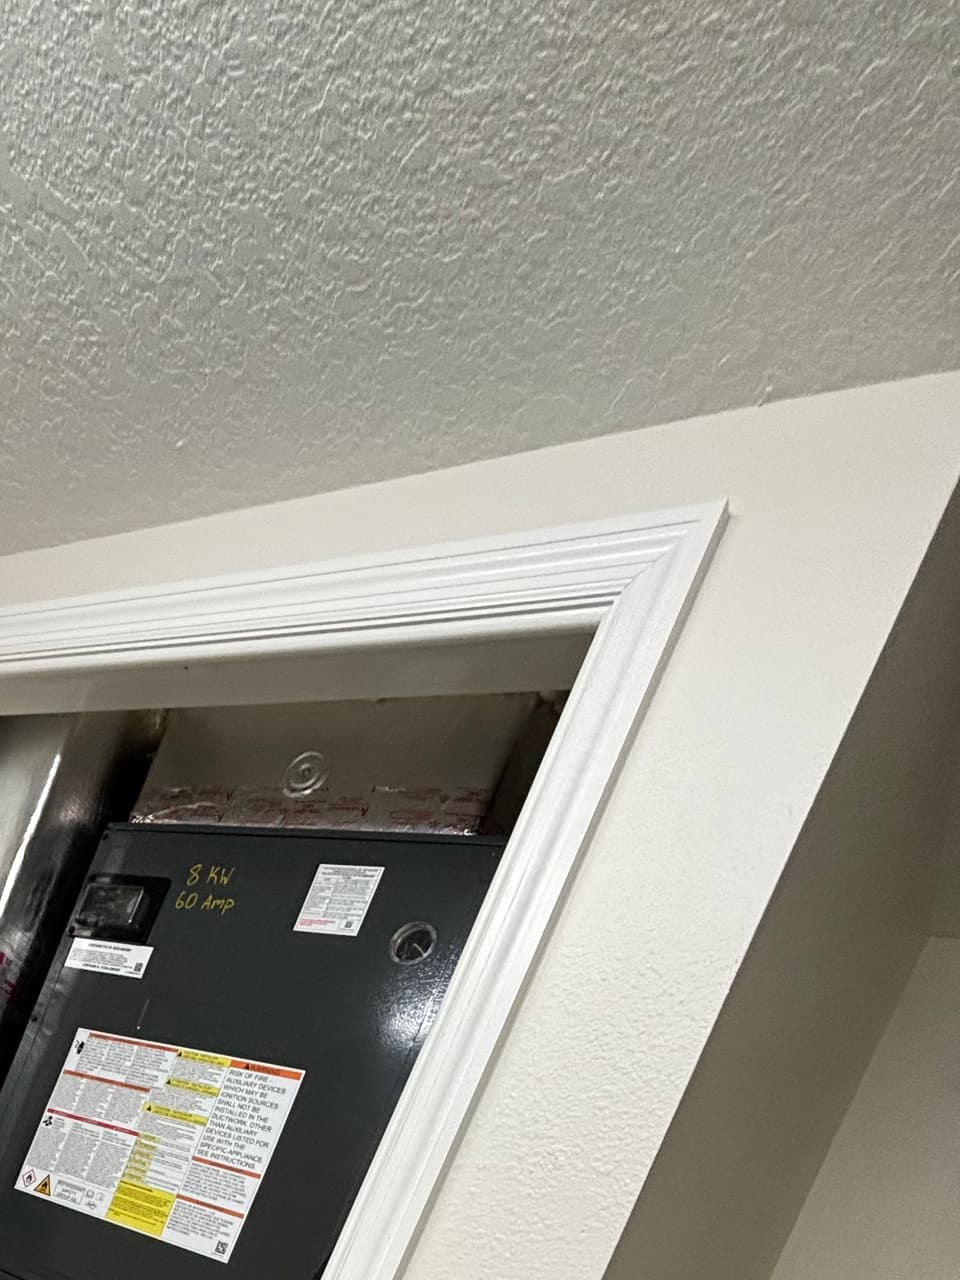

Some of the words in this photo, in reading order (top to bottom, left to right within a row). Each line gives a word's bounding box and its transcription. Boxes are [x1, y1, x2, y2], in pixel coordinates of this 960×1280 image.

[186, 864, 202, 886] 8
[176, 891, 198, 909] 60
[200, 894, 235, 915] Amp
[223, 1084, 243, 1093] WHICH
[245, 1088, 258, 1096] MAY
[226, 1077, 257, 1088] AUXILIARY
[258, 1083, 286, 1094] DEVICES
[217, 1099, 235, 1107] SHALL
[220, 1092, 246, 1102] IGNITION
[248, 1097, 279, 1109] SOURCES
[215, 1106, 247, 1118] INSTALLED
[209, 1120, 224, 1128] THAN
[226, 1124, 257, 1136] AUXILIARY
[250, 1121, 271, 1132] OTHER
[206, 1127, 231, 1138] DEVICES
[233, 1134, 254, 1144] LISTED
[256, 1139, 269, 1147] FOR
[216, 1138, 232, 1146] WITH
[234, 1142, 245, 1150] THE
[200, 1141, 226, 1153] SPECIFIC
